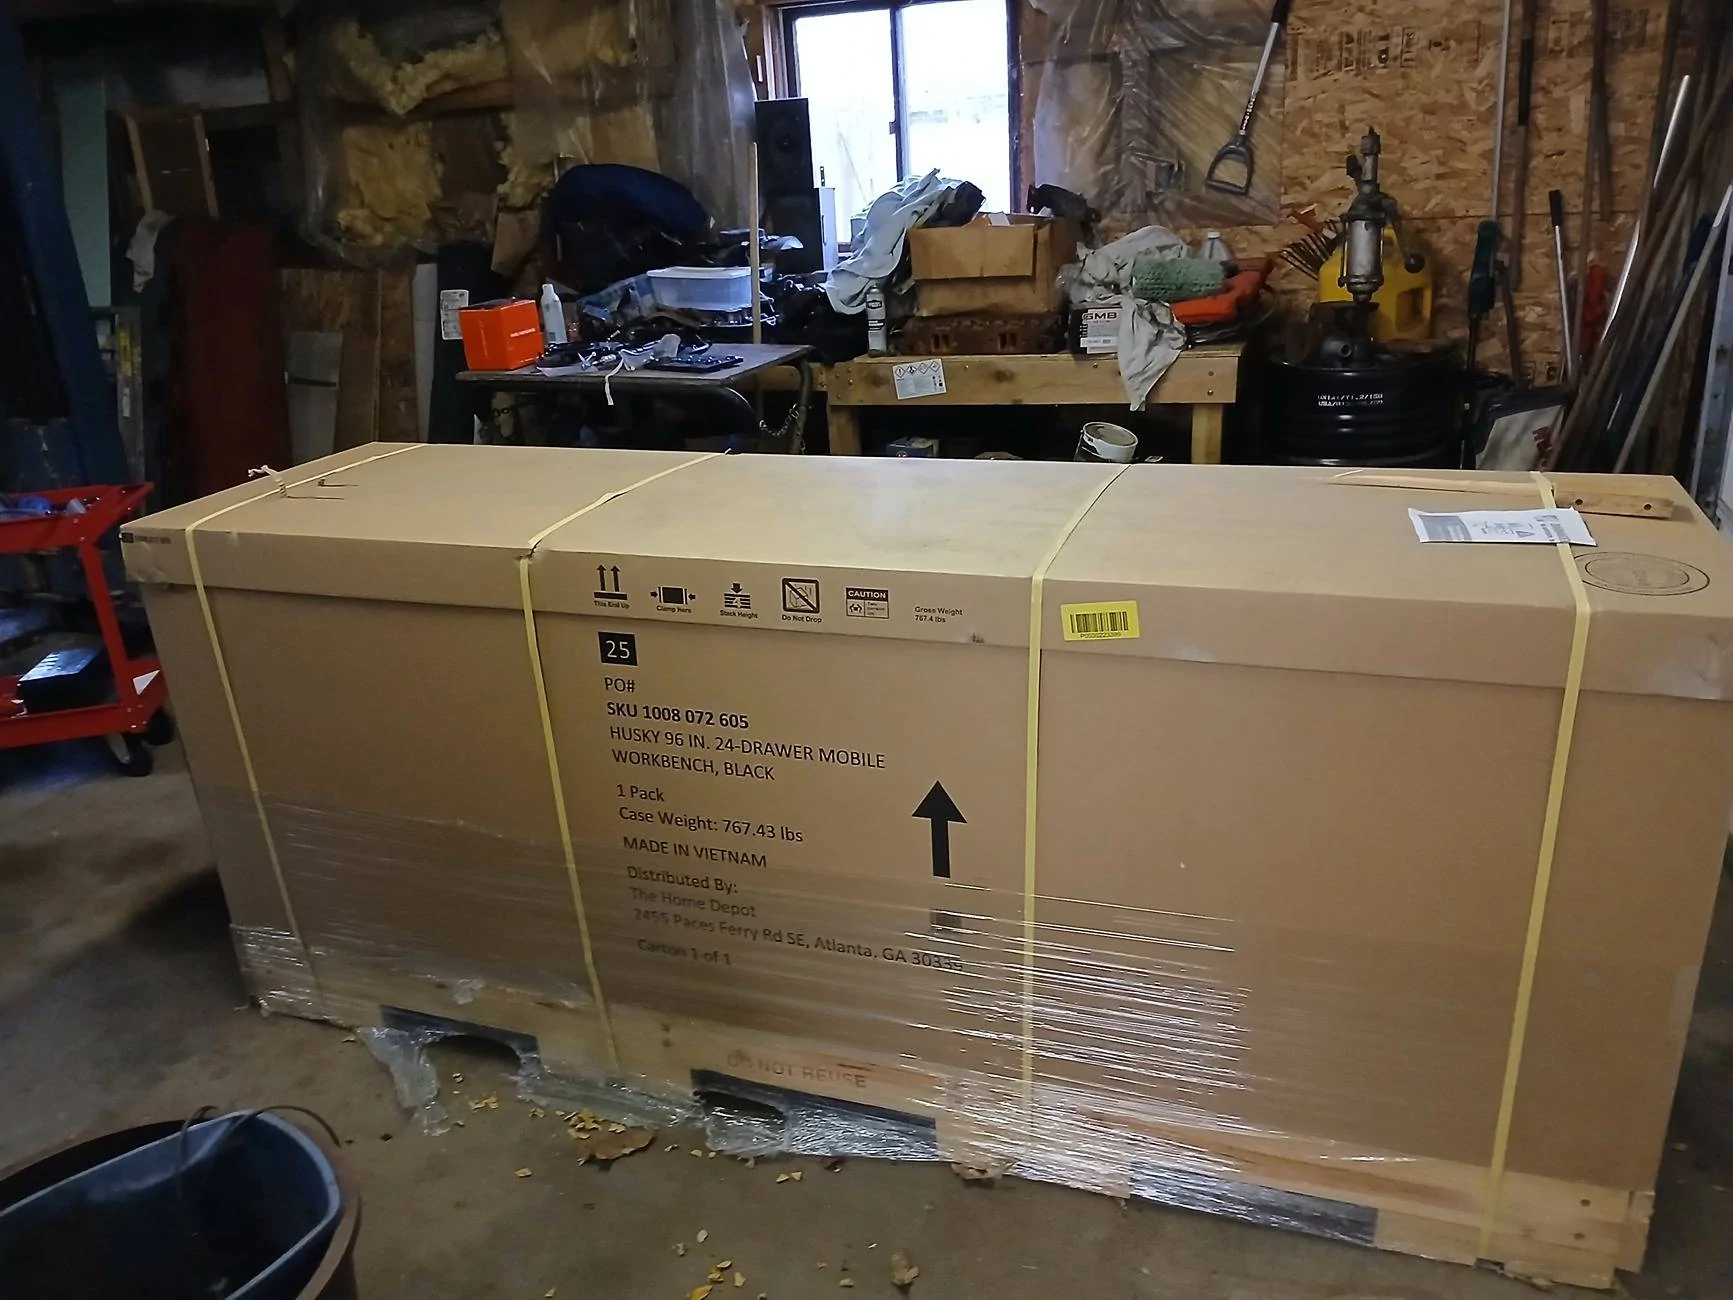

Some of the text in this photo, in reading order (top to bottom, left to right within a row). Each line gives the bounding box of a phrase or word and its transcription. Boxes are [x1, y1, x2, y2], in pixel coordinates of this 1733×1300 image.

[1083, 311, 1117, 320] GMB
[847, 590, 887, 599] CAUTION
[656, 605, 676, 613] Clamp
[719, 609, 758, 619] Stack Height
[914, 606, 963, 616] Gross Weight
[915, 614, 933, 622] 767.4
[605, 640, 630, 659] 25
[604, 677, 635, 693] PO#
[607, 701, 749, 729] SKU 1008 072 605
[610, 726, 886, 769] HUSKY 96 IN. 24-DRAWER MOBILE
[611, 748, 775, 781] WORKBENCH, BLACK
[616, 783, 665, 802] 1 Pack
[619, 806, 803, 843] Case Weight: 767.43 lbs
[623, 836, 767, 868] MADE IN VIETNAM
[626, 865, 738, 894] Distributed By:
[629, 886, 757, 918] The Home Depot
[633, 908, 670, 924] 2455
[672, 913, 715, 933] Paces
[718, 921, 758, 941] Ferry
[762, 928, 783, 943] Rd
[786, 931, 810, 949] SE,
[882, 947, 907, 963] GA
[638, 938, 732, 966] Carton 1 of 1
[757, 1056, 793, 1076] NOT
[802, 1066, 867, 1089] REUSE
